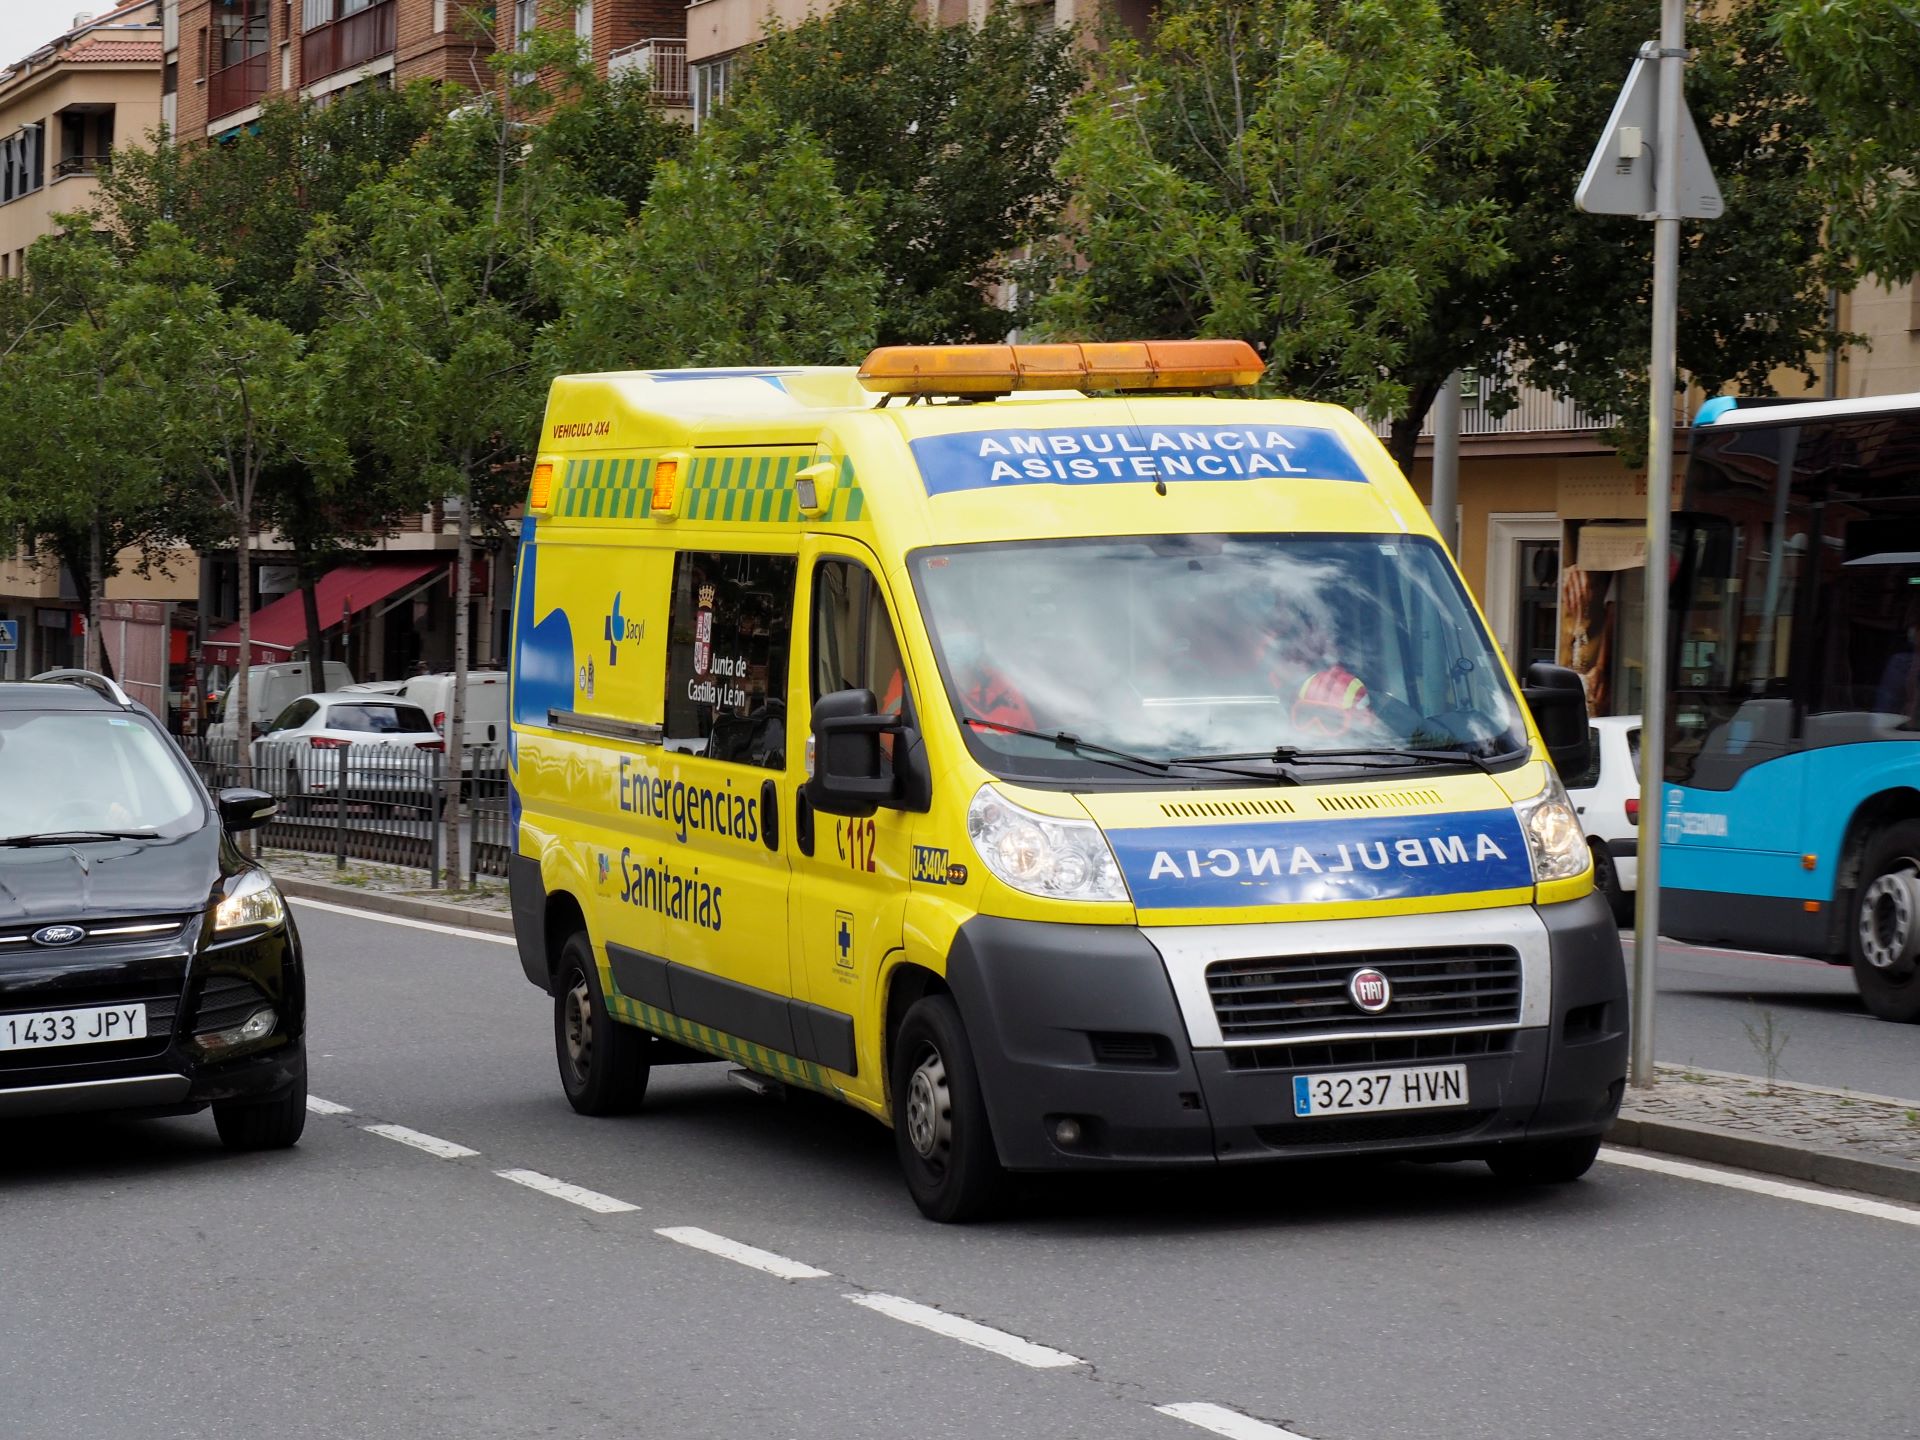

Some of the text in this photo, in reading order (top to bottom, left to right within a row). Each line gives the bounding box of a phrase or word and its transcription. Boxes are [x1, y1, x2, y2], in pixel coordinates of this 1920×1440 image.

[553, 421, 610, 439] VEHICULO 4X4
[979, 431, 1296, 457] AMBULANCIA
[990, 453, 1307, 481] ASISTENCIAL
[626, 618, 645, 646] Sacyl
[710, 653, 746, 678] Junta de
[688, 678, 745, 710] Castilla y León
[619, 755, 758, 844] Emergencias
[846, 817, 876, 873] 112
[913, 847, 947, 883] U-3404
[620, 846, 722, 932] Sanitarias
[44, 928, 74, 941] Ford
[1359, 980, 1383, 1002] FIAT
[8, 1009, 137, 1045] 1433 JPY
[1316, 1070, 1461, 1108] 3237 HVN
